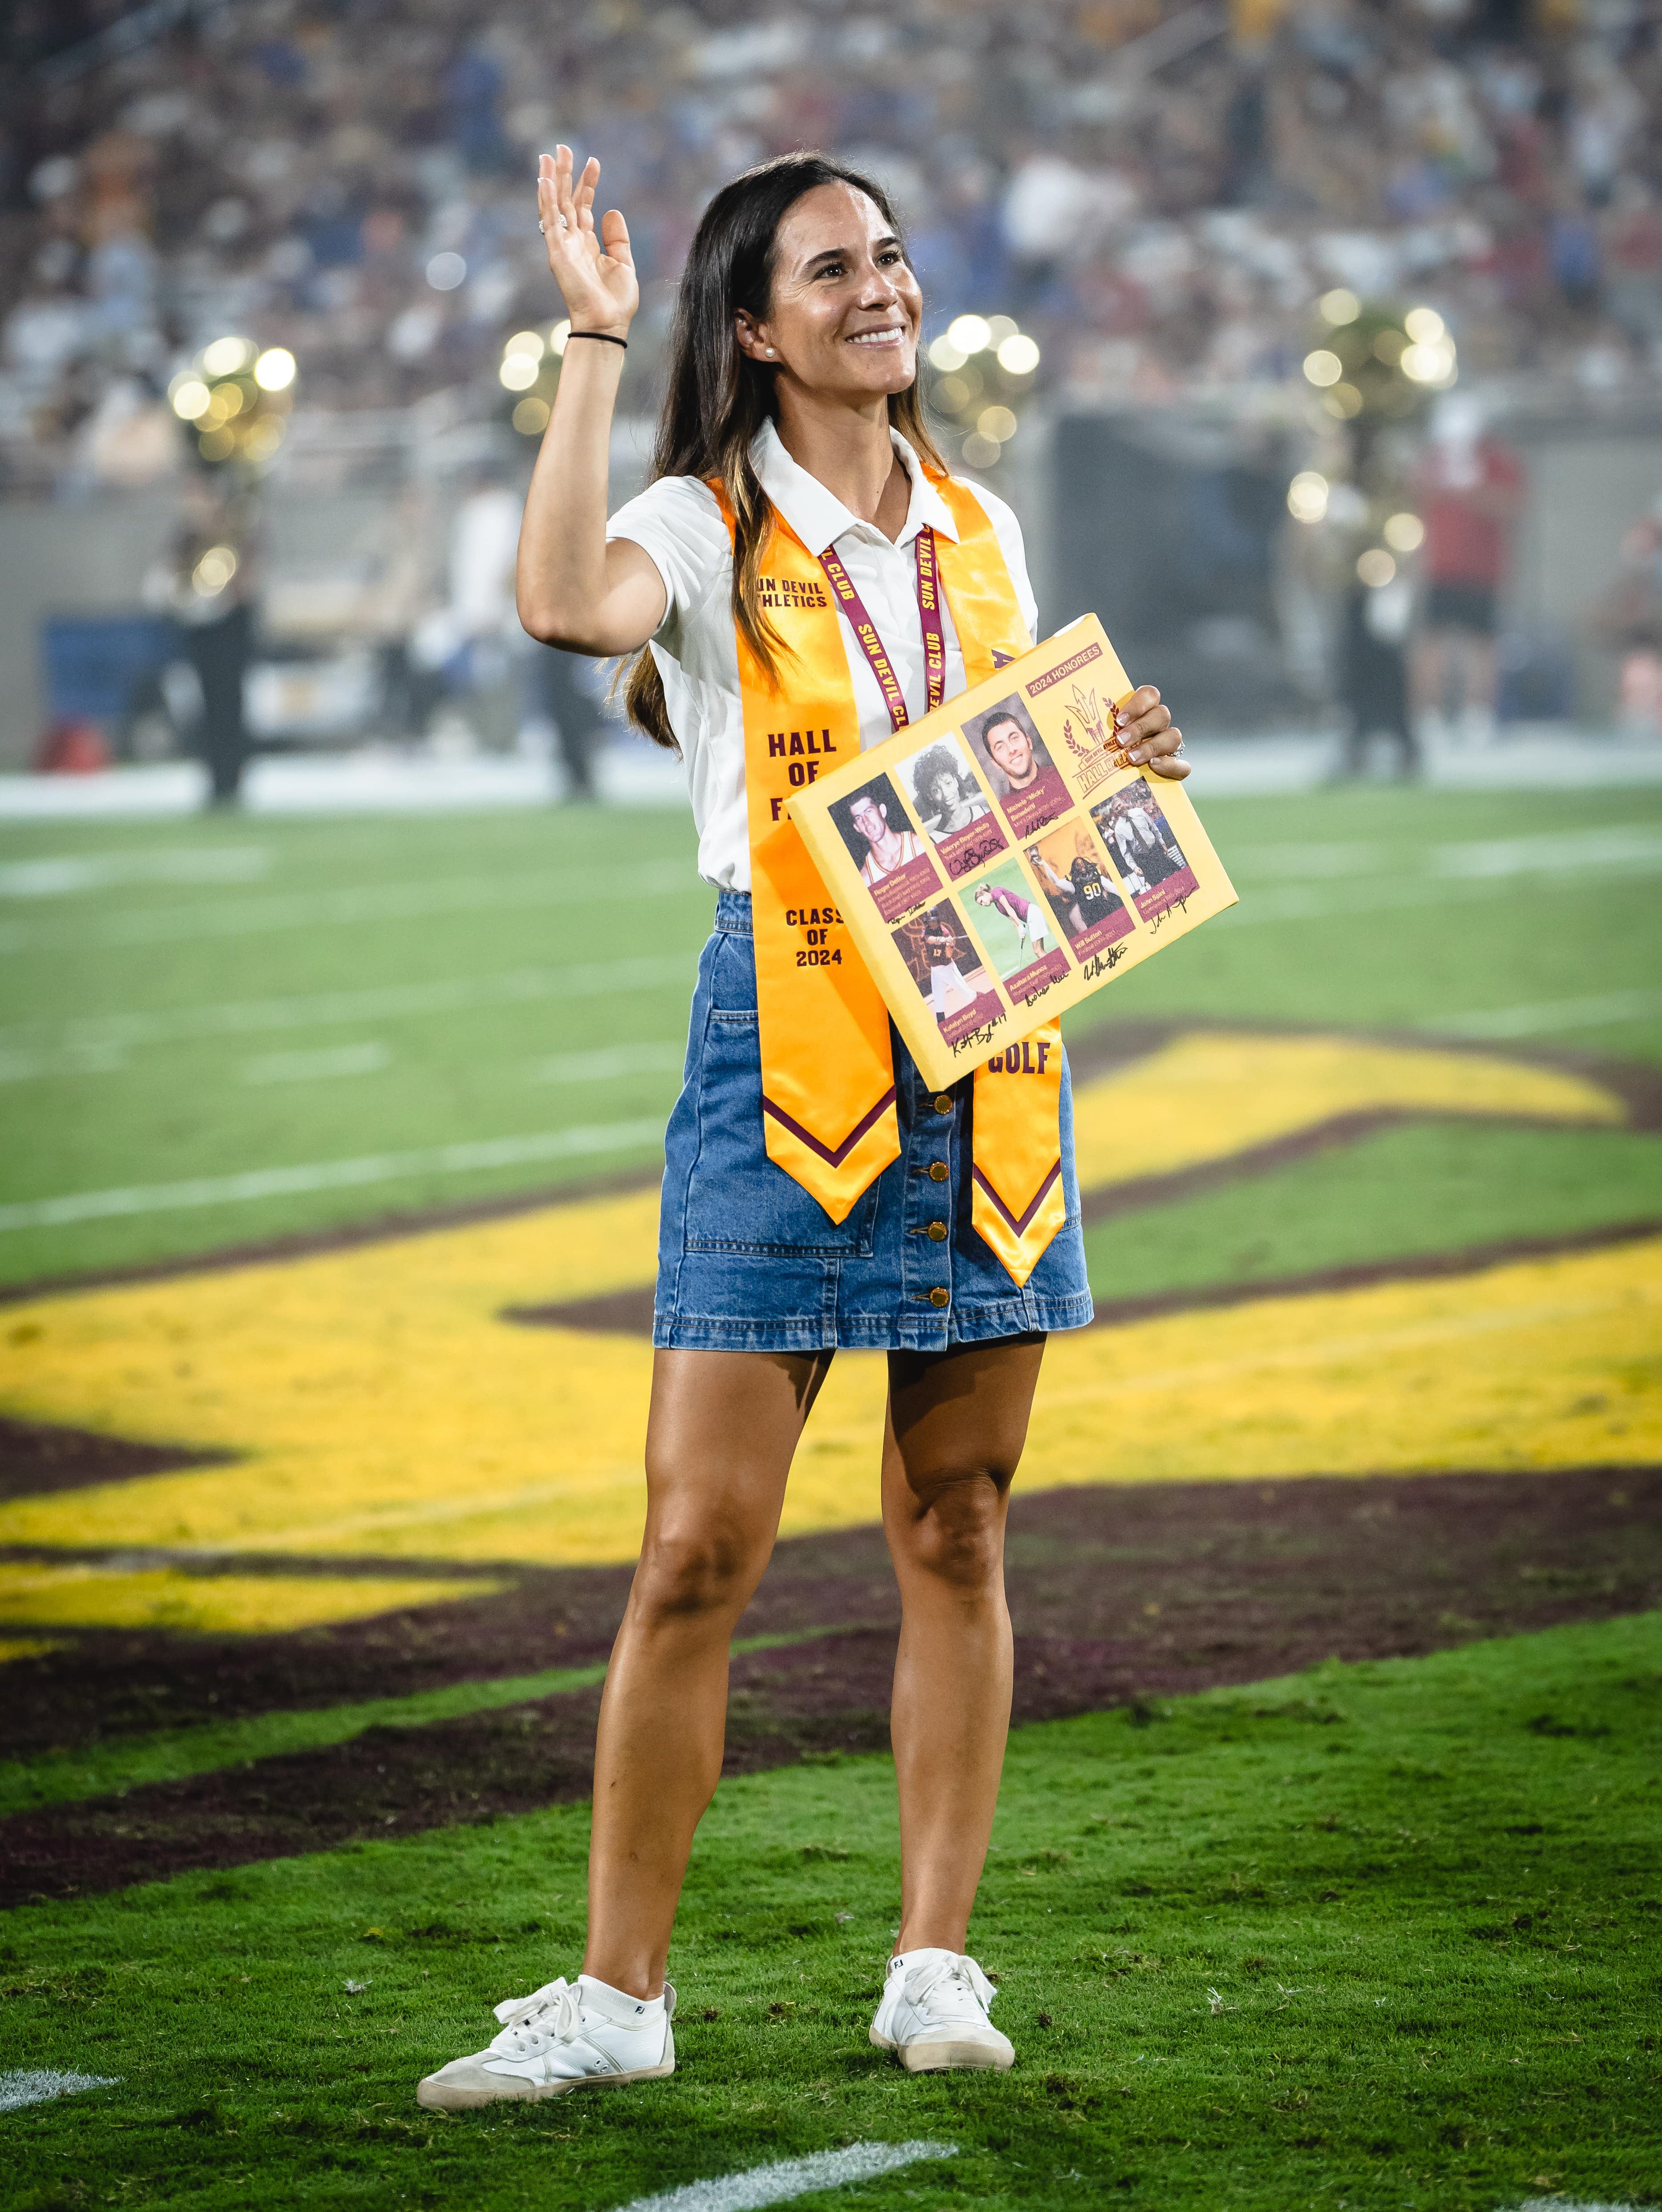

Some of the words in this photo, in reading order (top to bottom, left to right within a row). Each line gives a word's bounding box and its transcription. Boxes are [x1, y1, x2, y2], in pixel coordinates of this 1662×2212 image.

[919, 538, 933, 578] DEVIL
[757, 579, 776, 591] UN
[782, 579, 823, 594] DEVIL
[828, 563, 855, 600] CLUB
[757, 594, 827, 608] HLETICS
[922, 579, 935, 610] SUN
[926, 632, 942, 669] CLUB
[858, 624, 880, 656] SUN
[873, 658, 900, 702] DEVIL
[893, 705, 909, 730] CL
[1030, 675, 1053, 694] 2024
[1051, 646, 1100, 681] HONOREES
[768, 729, 837, 757] HALL
[1093, 747, 1104, 758] DEVIL
[1103, 739, 1117, 750] ATHLET
[788, 761, 819, 786] OF
[1077, 762, 1108, 793] HALL
[1006, 798, 1027, 814] Michele
[1010, 802, 1036, 822] Benedetti
[1083, 883, 1101, 900] 90
[1139, 896, 1153, 908] John
[1151, 888, 1166, 900] Spini
[786, 907, 844, 926] CLASS
[807, 928, 828, 945] OF
[1074, 939, 1086, 950] Will
[1084, 929, 1103, 944] Sutton
[796, 949, 842, 967] 2024
[1008, 974, 1031, 991] Azahara
[942, 1017, 964, 1033] Katelyn
[962, 1008, 977, 1021] Boyd
[988, 1041, 1051, 1074] GOLF
